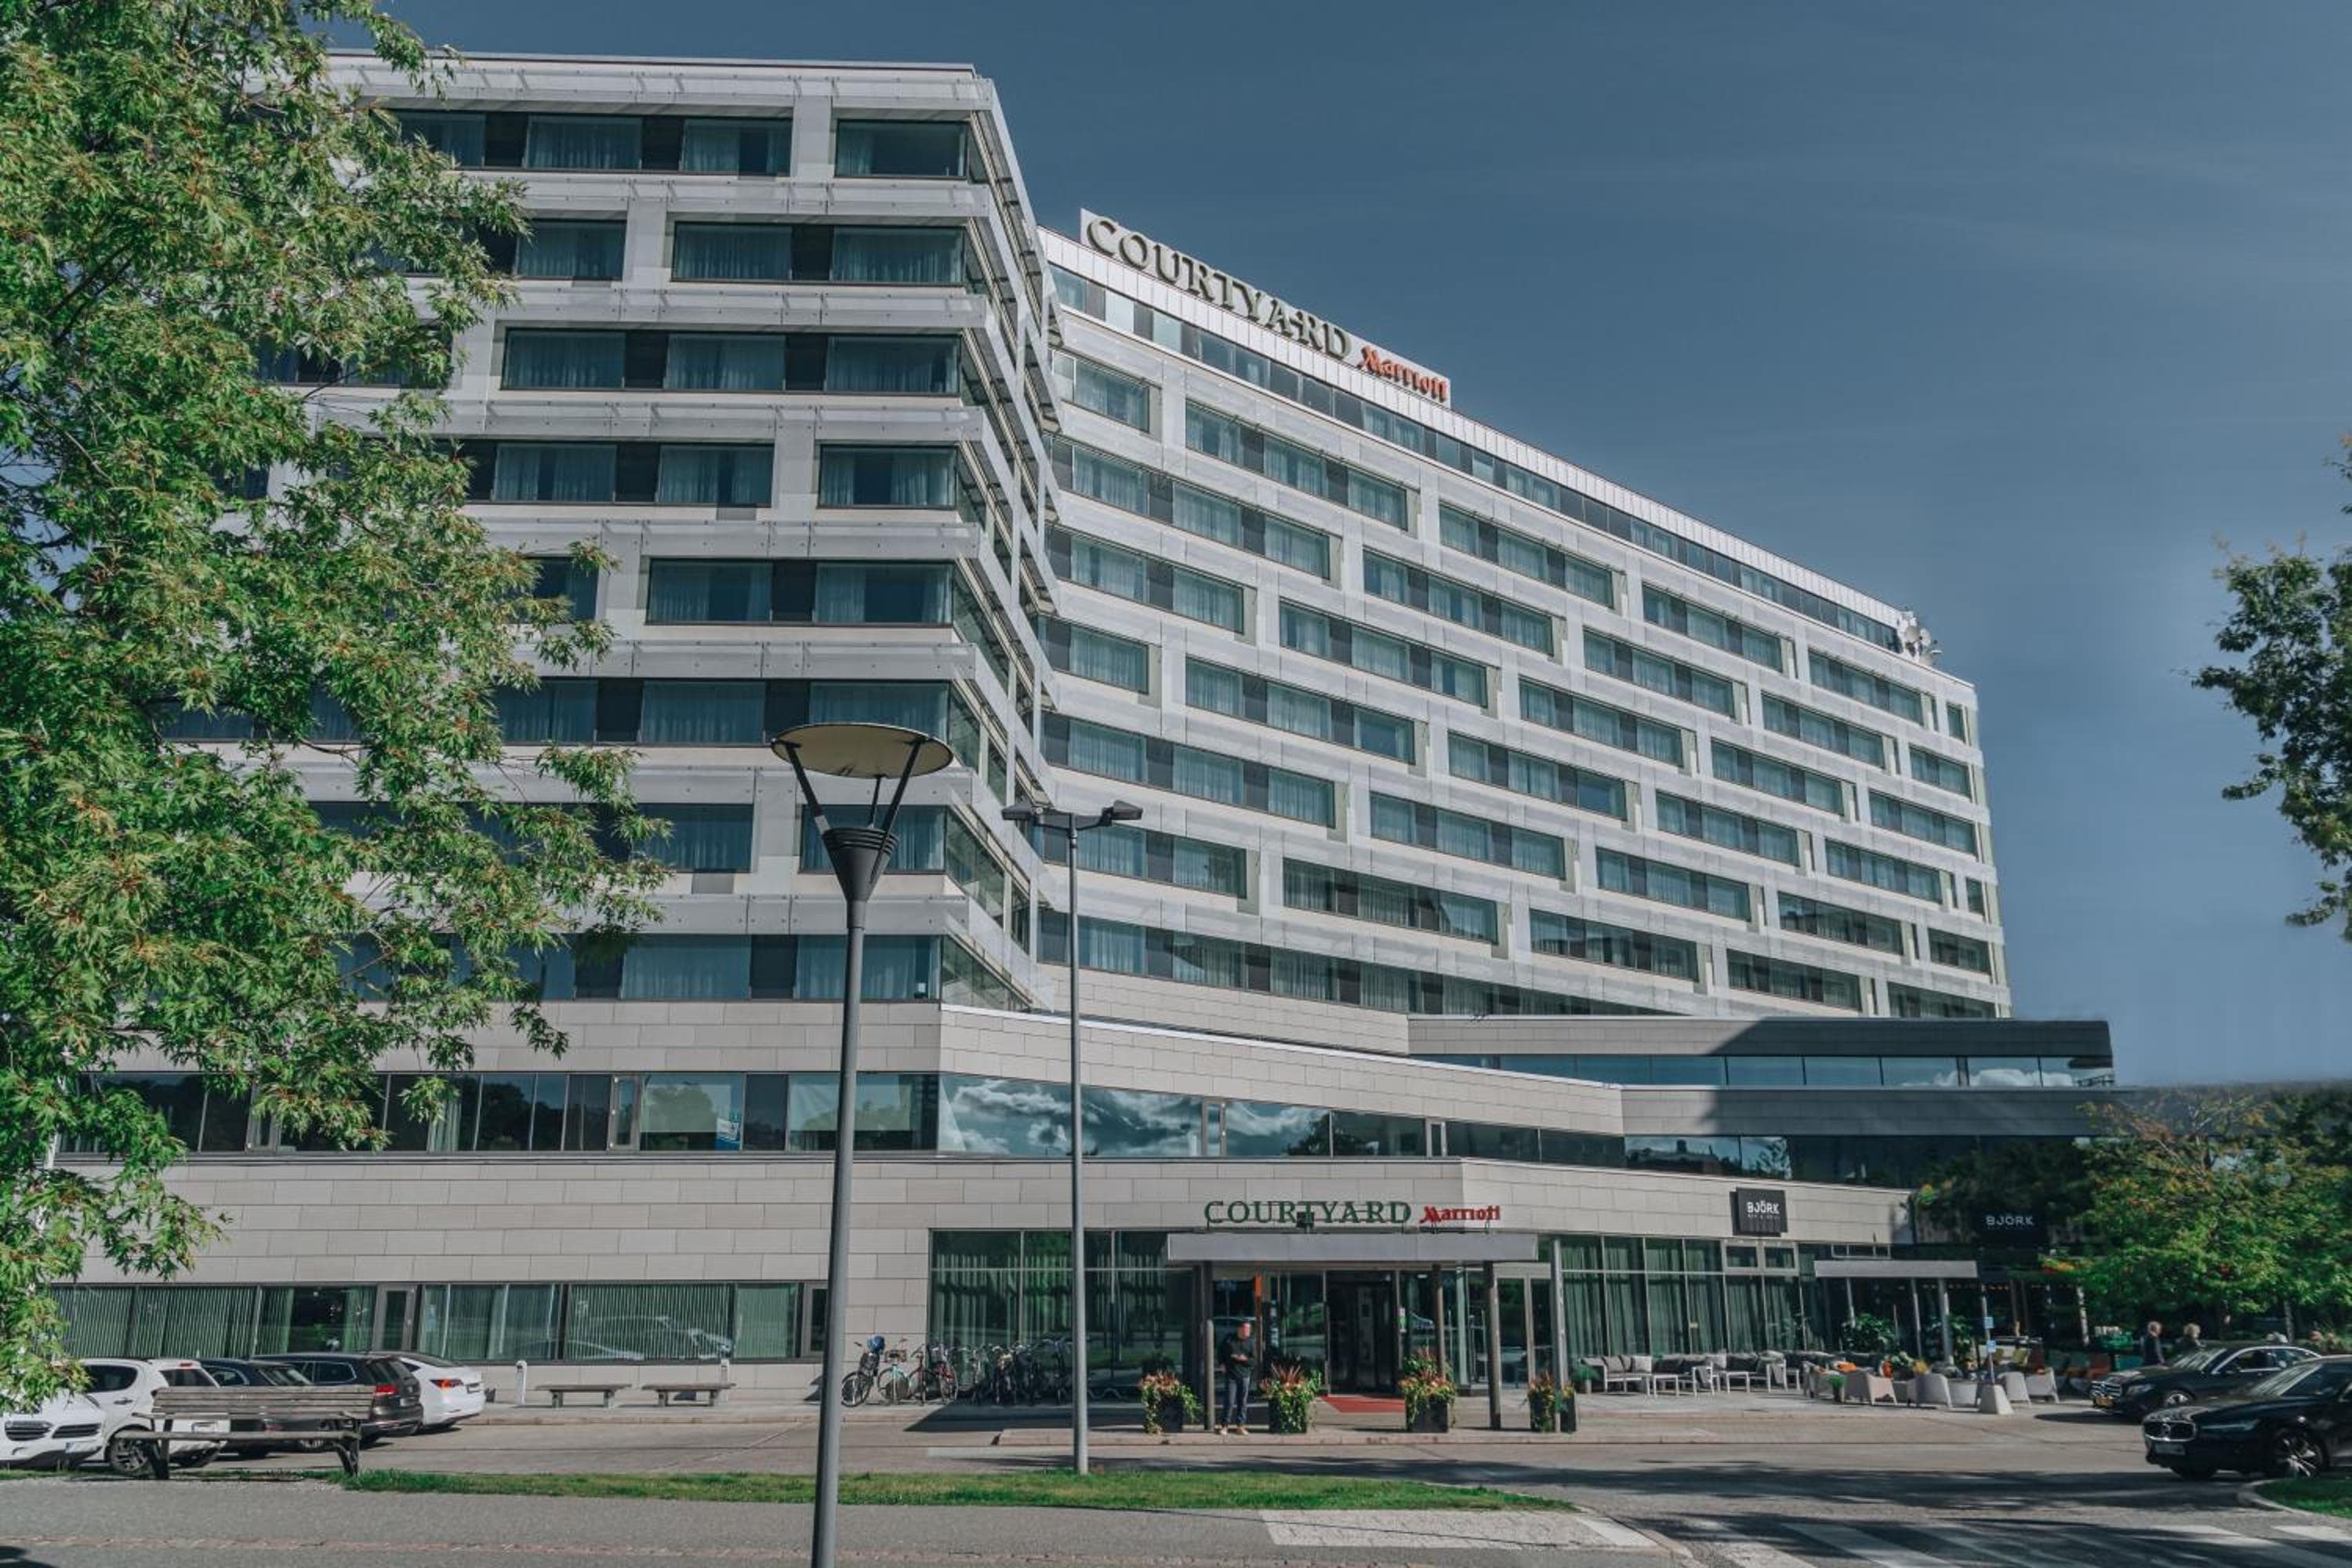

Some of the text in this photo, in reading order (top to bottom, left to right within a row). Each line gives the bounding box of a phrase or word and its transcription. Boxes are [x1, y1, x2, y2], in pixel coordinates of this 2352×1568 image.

[1087, 217, 1448, 402] COURTYARD Marriott
[1204, 1200, 1501, 1224] COURTYARD Marriott
[1747, 1200, 1780, 1214] BJÖRK
